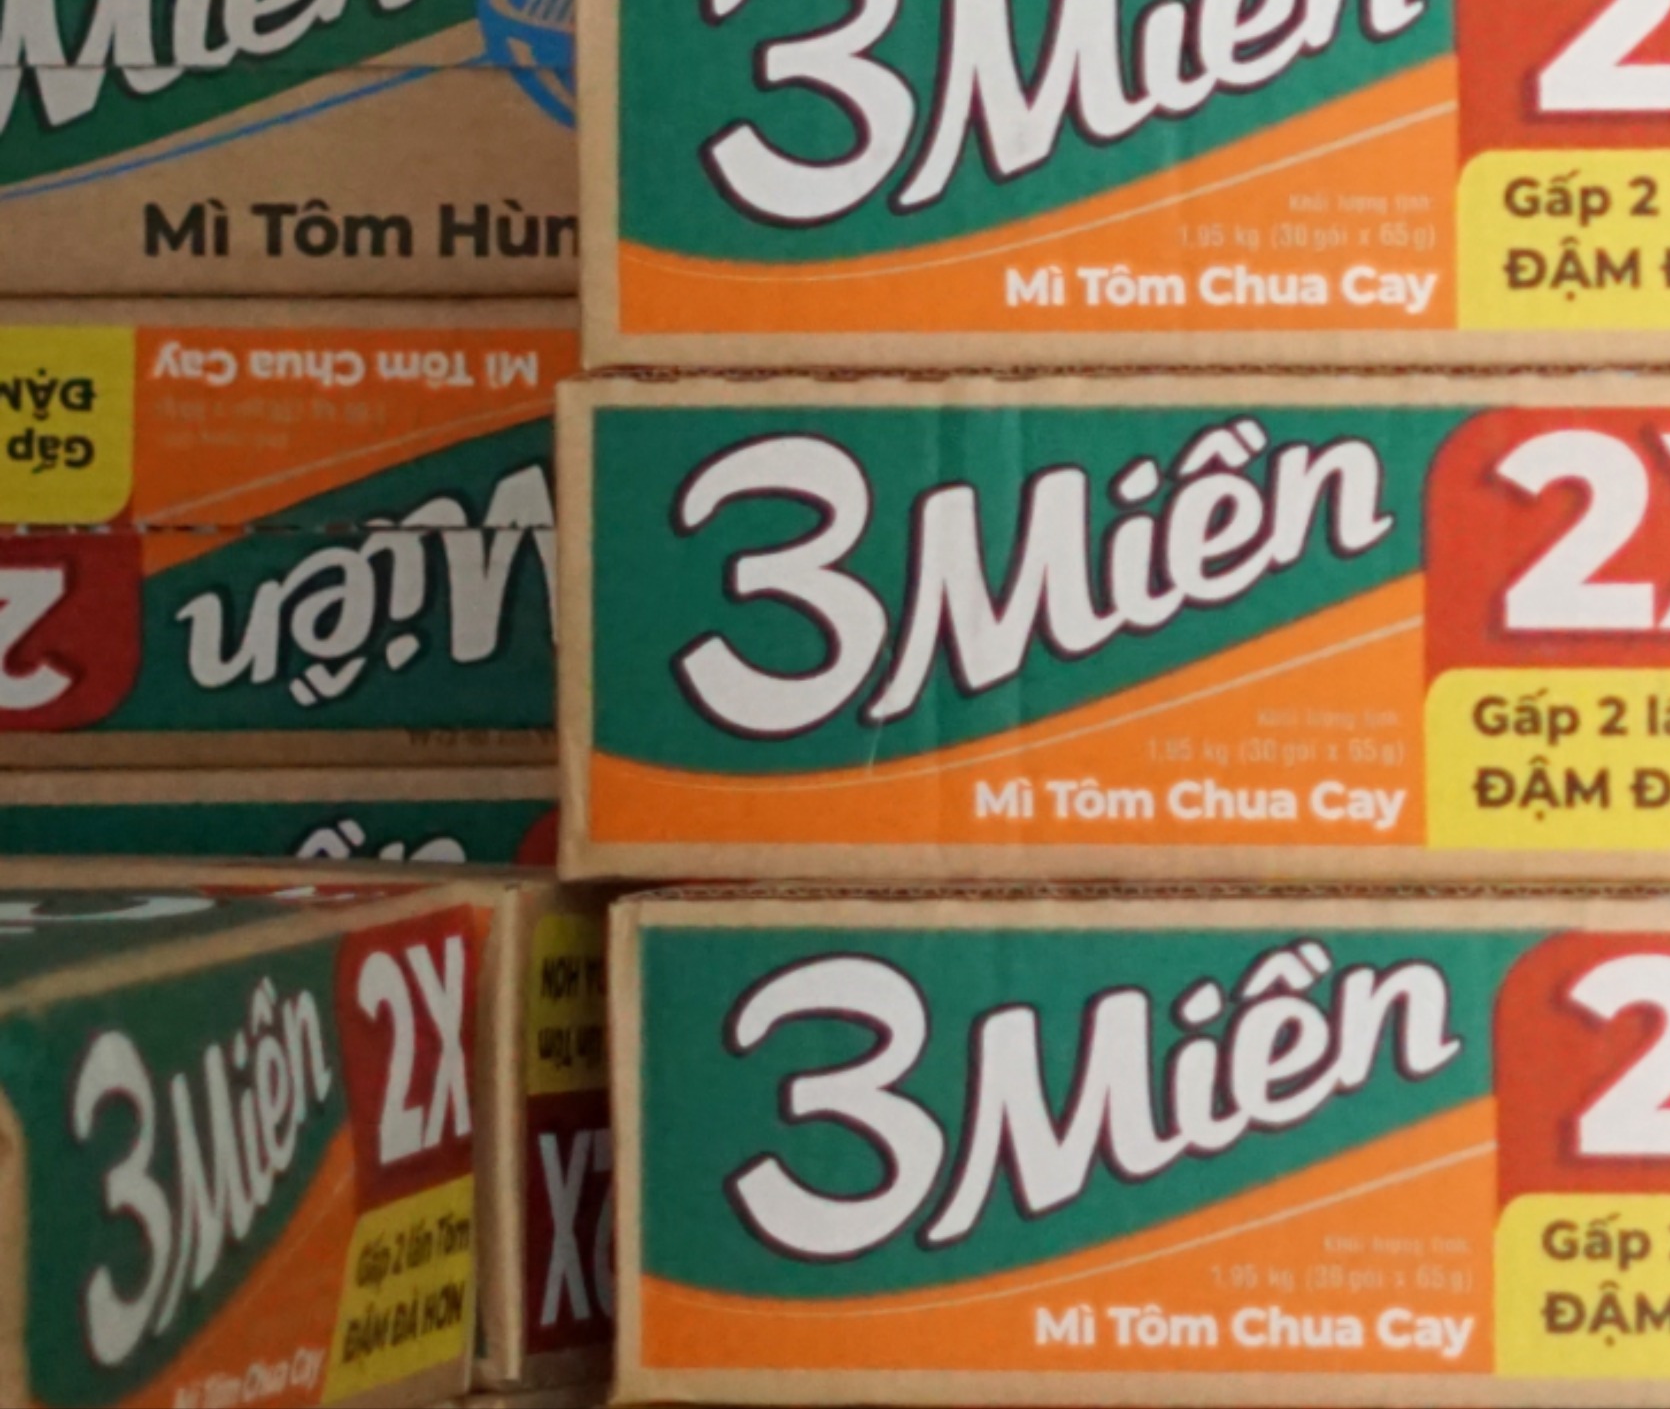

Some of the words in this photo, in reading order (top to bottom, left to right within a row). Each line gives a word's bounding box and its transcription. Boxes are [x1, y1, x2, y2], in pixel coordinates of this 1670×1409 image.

[1504, 171, 1610, 226] Gấp
[1632, 178, 1659, 216] 2
[144, 202, 229, 258] Mì
[251, 198, 414, 258] Tôm
[1006, 265, 1065, 307] Mì
[1077, 263, 1184, 307] Tôm
[1199, 264, 1328, 306] Chua
[1342, 264, 1438, 315] Cay
[1504, 236, 1641, 302] ĐẬM
[154, 342, 237, 386] Cay
[250, 347, 366, 386] Chua
[379, 348, 474, 388] Tôm
[487, 352, 538, 387] Mì
[7, 432, 94, 473] Gấp
[1474, 693, 1578, 745] Gấp
[1600, 700, 1627, 736] 2
[974, 781, 1034, 821] Mì
[1046, 778, 1153, 821] Tôm
[1167, 778, 1297, 820] Chua
[1310, 779, 1406, 829] Cay
[1474, 759, 1610, 821] ĐẬM
[357, 935, 472, 1166] 2X
[1543, 1216, 1651, 1270] Gấp
[1034, 1305, 1095, 1347] Mì
[1106, 1303, 1218, 1348] Tôm
[1231, 1305, 1365, 1349] Chua
[1376, 1306, 1474, 1359] Cay
